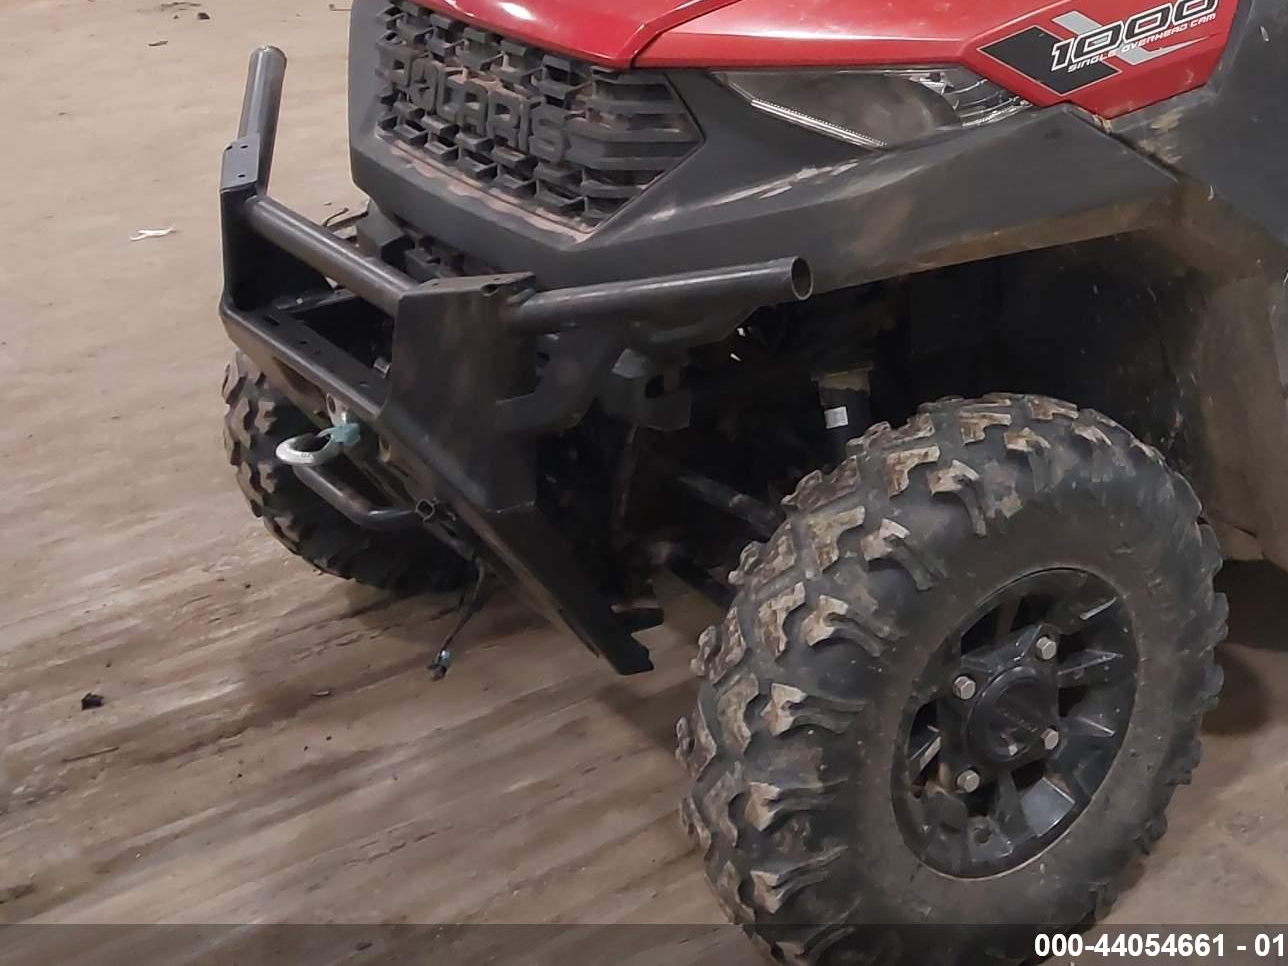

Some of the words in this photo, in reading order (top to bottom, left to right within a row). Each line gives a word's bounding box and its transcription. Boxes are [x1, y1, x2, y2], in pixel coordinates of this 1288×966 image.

[1068, 50, 1117, 73] SINGLE
[1121, 24, 1188, 54] OVERHEAD
[1190, 12, 1217, 29] CAM
[378, 38, 567, 164] POLARIS
